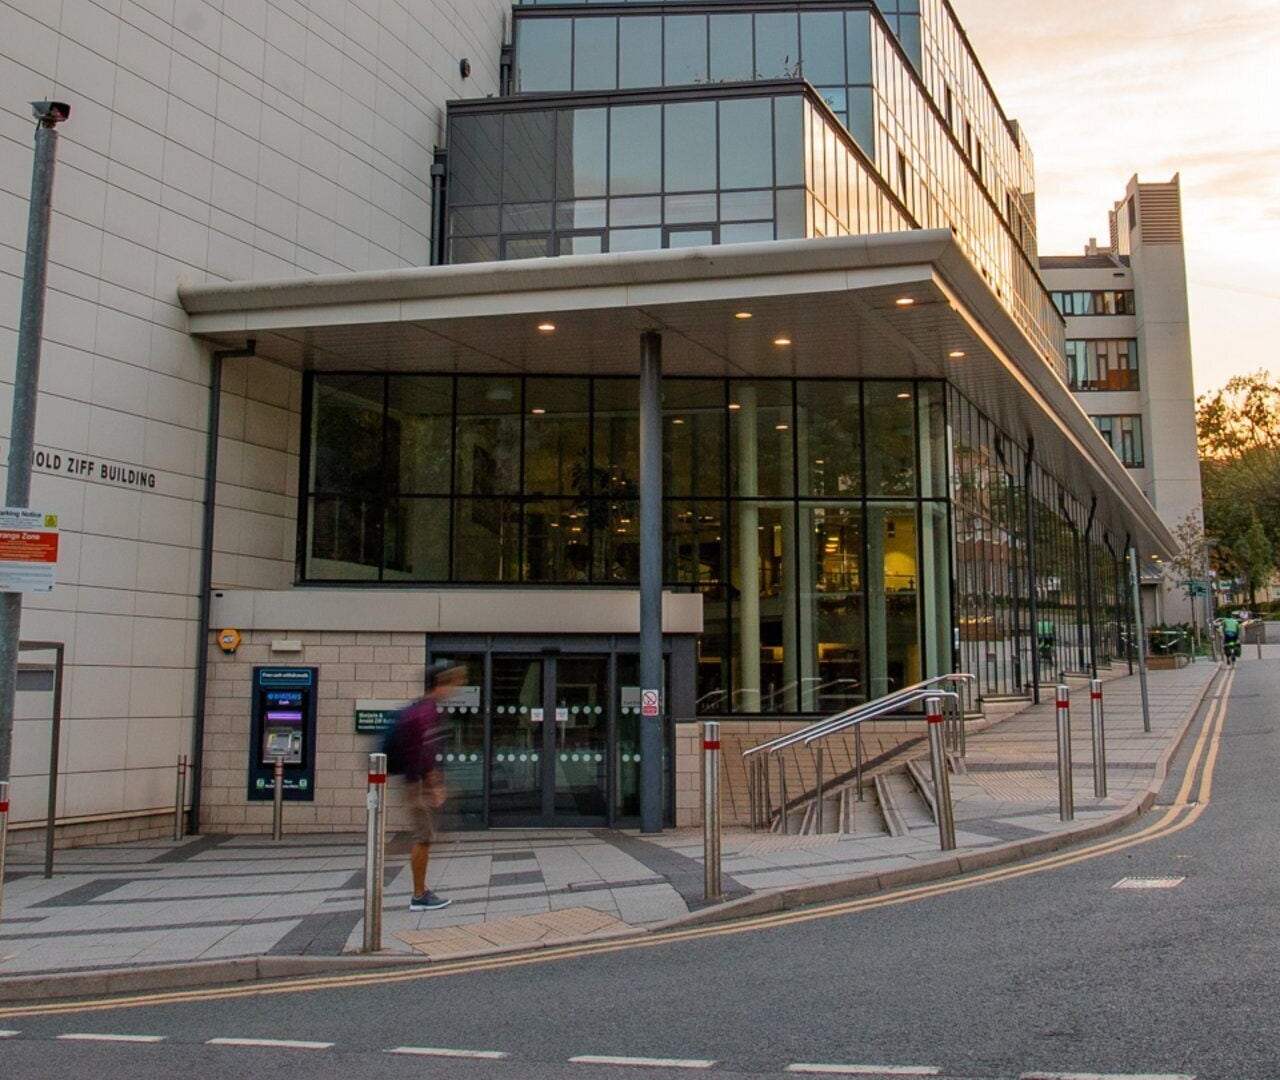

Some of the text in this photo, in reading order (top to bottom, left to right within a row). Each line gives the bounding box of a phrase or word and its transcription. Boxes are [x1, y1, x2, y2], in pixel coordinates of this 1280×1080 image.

[67, 457, 95, 476] ZIFF
[101, 464, 156, 488] BUILDING
[21, 532, 41, 540] Zone
